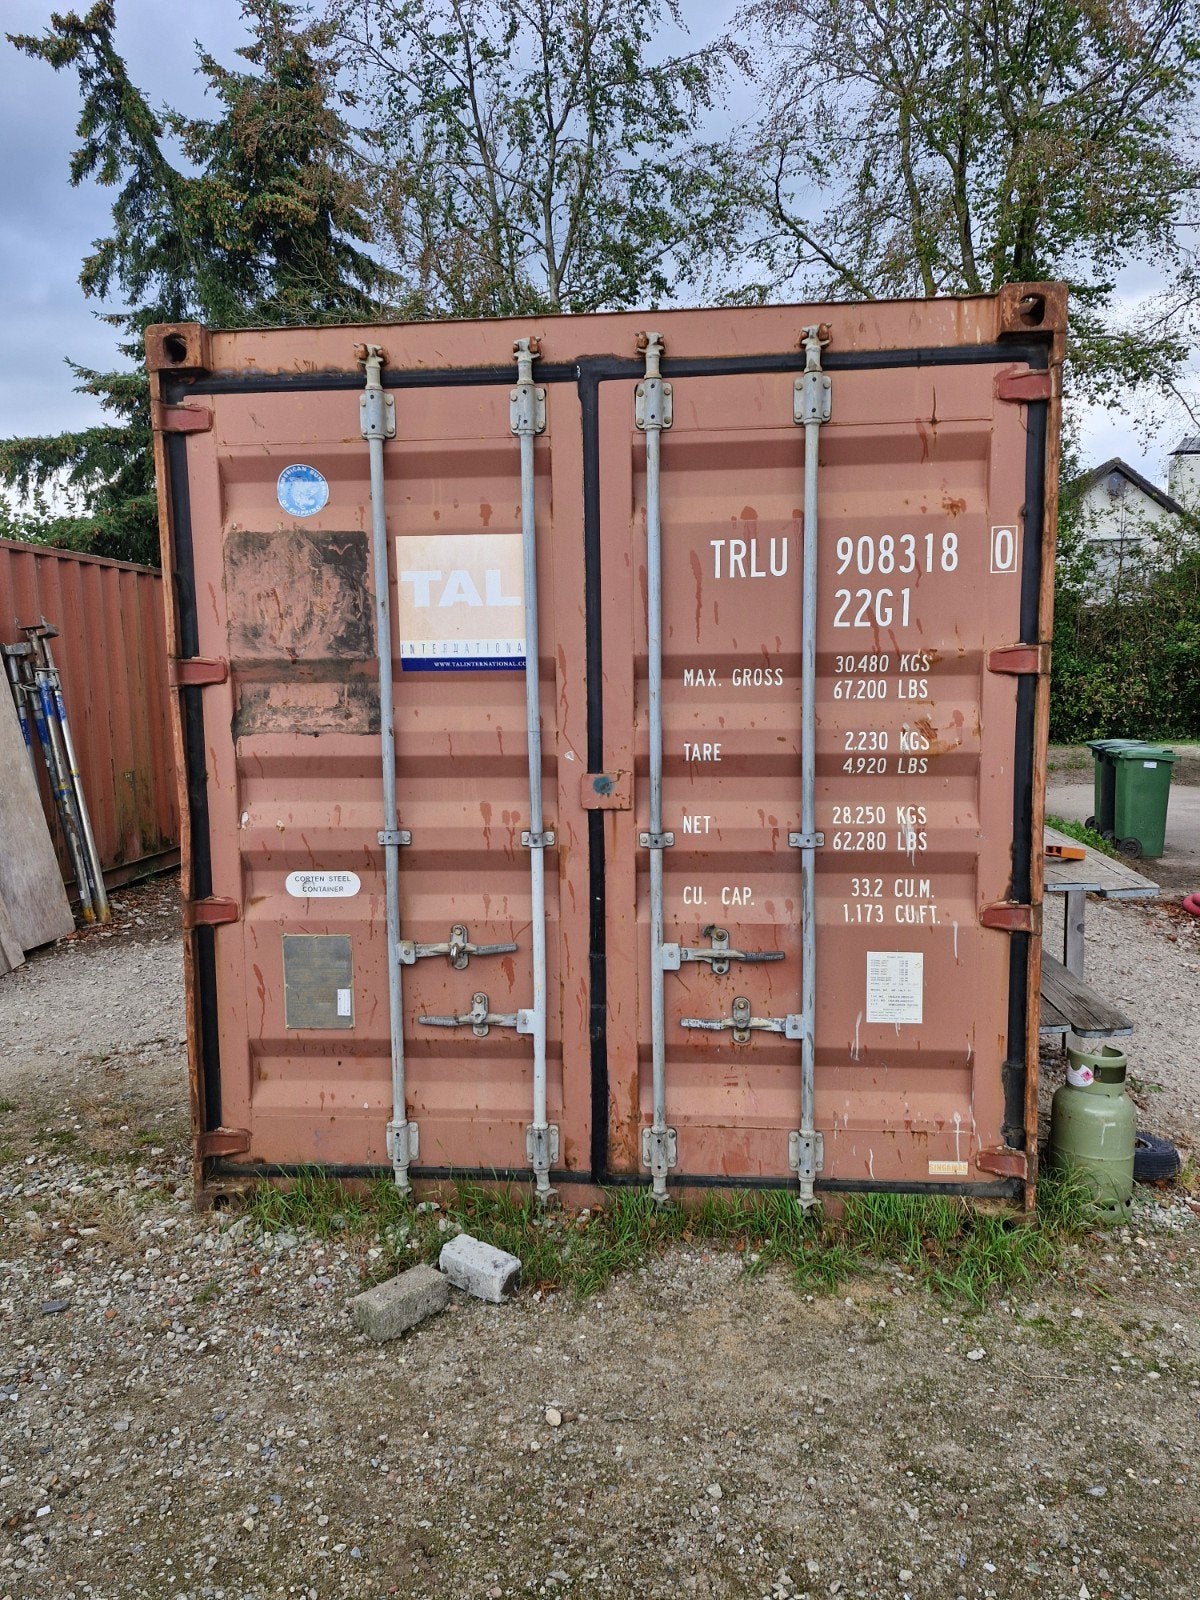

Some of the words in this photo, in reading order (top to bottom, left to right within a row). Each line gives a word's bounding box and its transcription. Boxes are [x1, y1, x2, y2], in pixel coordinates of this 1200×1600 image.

[710, 537, 789, 579] TRLU
[836, 532, 959, 575] 908318
[994, 530, 1014, 569] 0
[400, 569, 522, 608] TAL
[833, 587, 911, 628] 22G1
[401, 642, 522, 655] INTERNATIONA
[899, 653, 931, 672] KGS
[683, 669, 722, 688] MAX.
[732, 668, 784, 686] GROSS
[898, 679, 929, 699] LBS
[899, 731, 931, 751] KGS
[683, 743, 722, 762] TARE
[897, 757, 929, 774] LBS
[682, 815, 711, 834] NET
[896, 806, 928, 825] KGS
[897, 831, 929, 851] LBS
[683, 886, 708, 905] CU.
[721, 886, 755, 906] CAP.
[851, 878, 883, 897] 33.2
[894, 878, 935, 899] CU.M.
